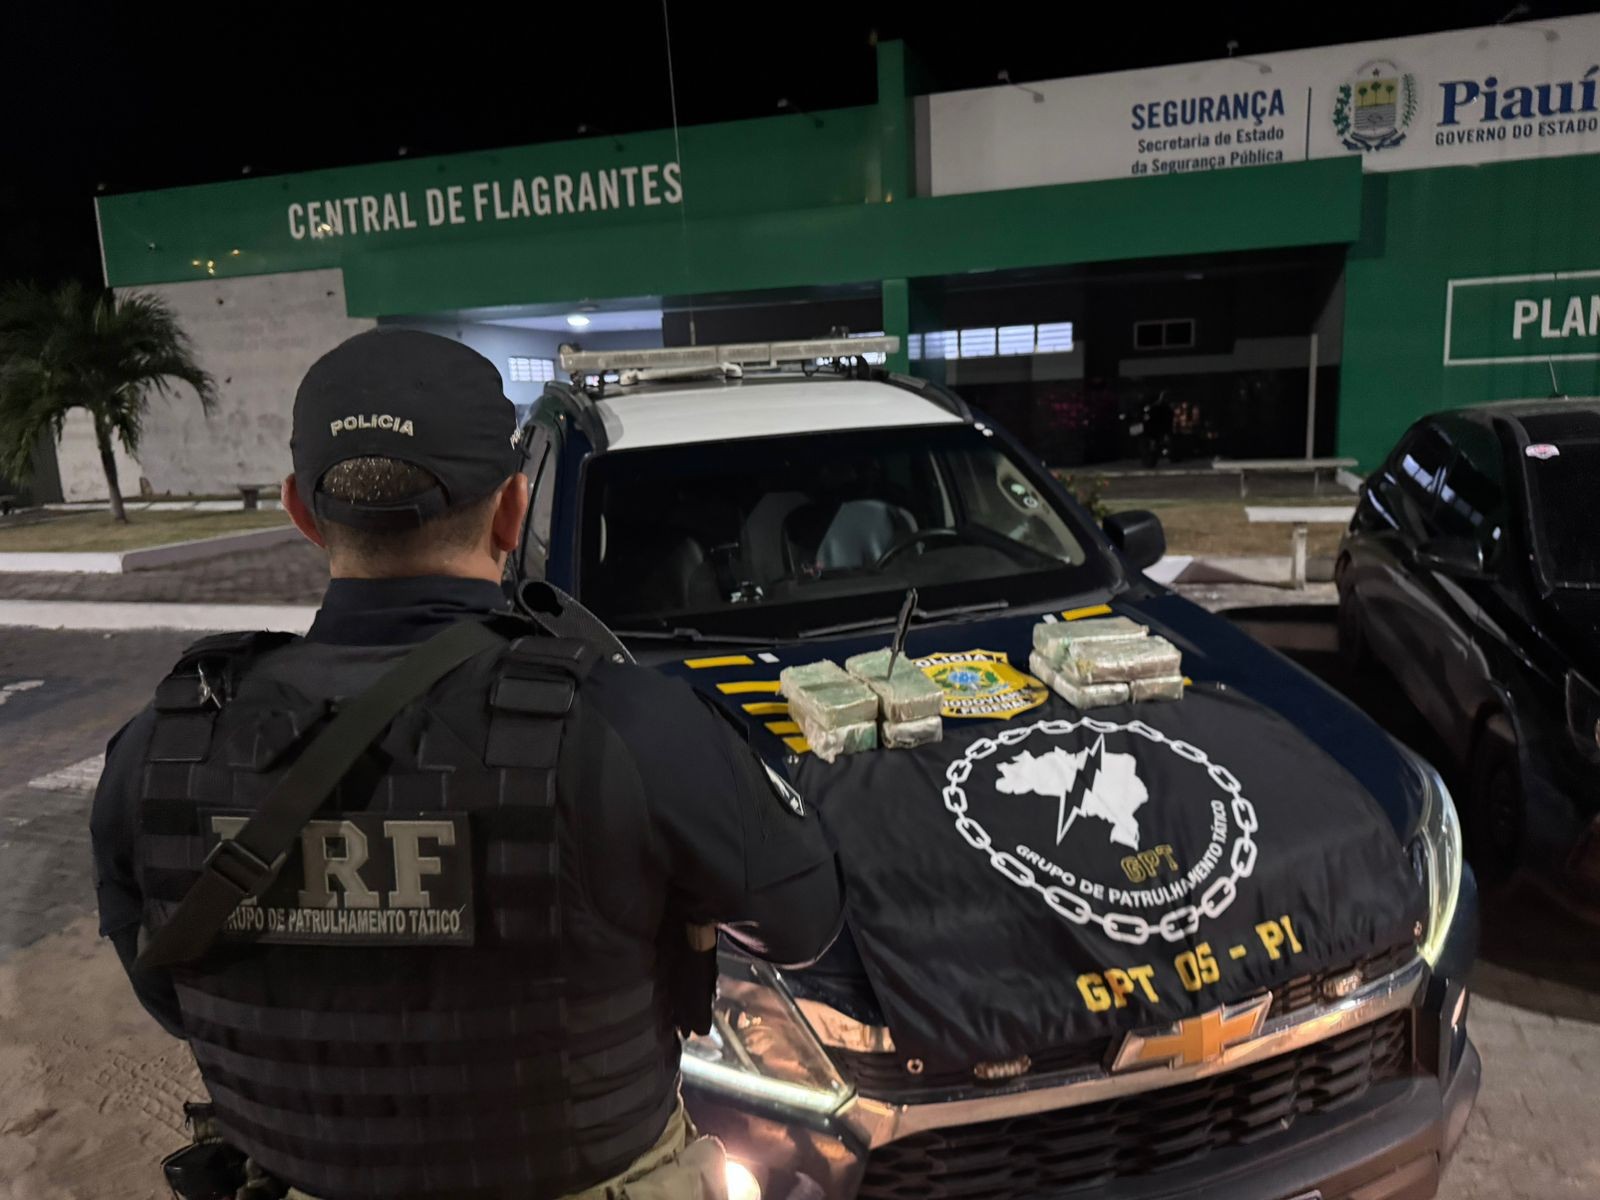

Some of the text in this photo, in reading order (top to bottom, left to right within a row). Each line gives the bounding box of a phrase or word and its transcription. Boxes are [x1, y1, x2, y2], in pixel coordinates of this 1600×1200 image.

[1132, 88, 1285, 130] SEGURANÇA
[1437, 65, 1599, 127] Piauí
[1138, 126, 1284, 154] Secretaria de Estado
[1435, 117, 1598, 146] GOVERNO DO ESTADO
[1131, 148, 1283, 175] da Segurança Pública
[288, 162, 683, 240] CENTRAL DE FLAGRANTES
[1015, 799, 1230, 908] GRUPO DE PATRULHAMENTO TÁTICO
[1120, 844, 1180, 884] GPT
[227, 907, 265, 930] RUPO
[268, 908, 285, 929] DE
[288, 908, 405, 934] PATRULHAMENTO
[1076, 964, 1160, 1012] GPT
[1174, 943, 1221, 991] 05
[1256, 915, 1302, 960] PI
